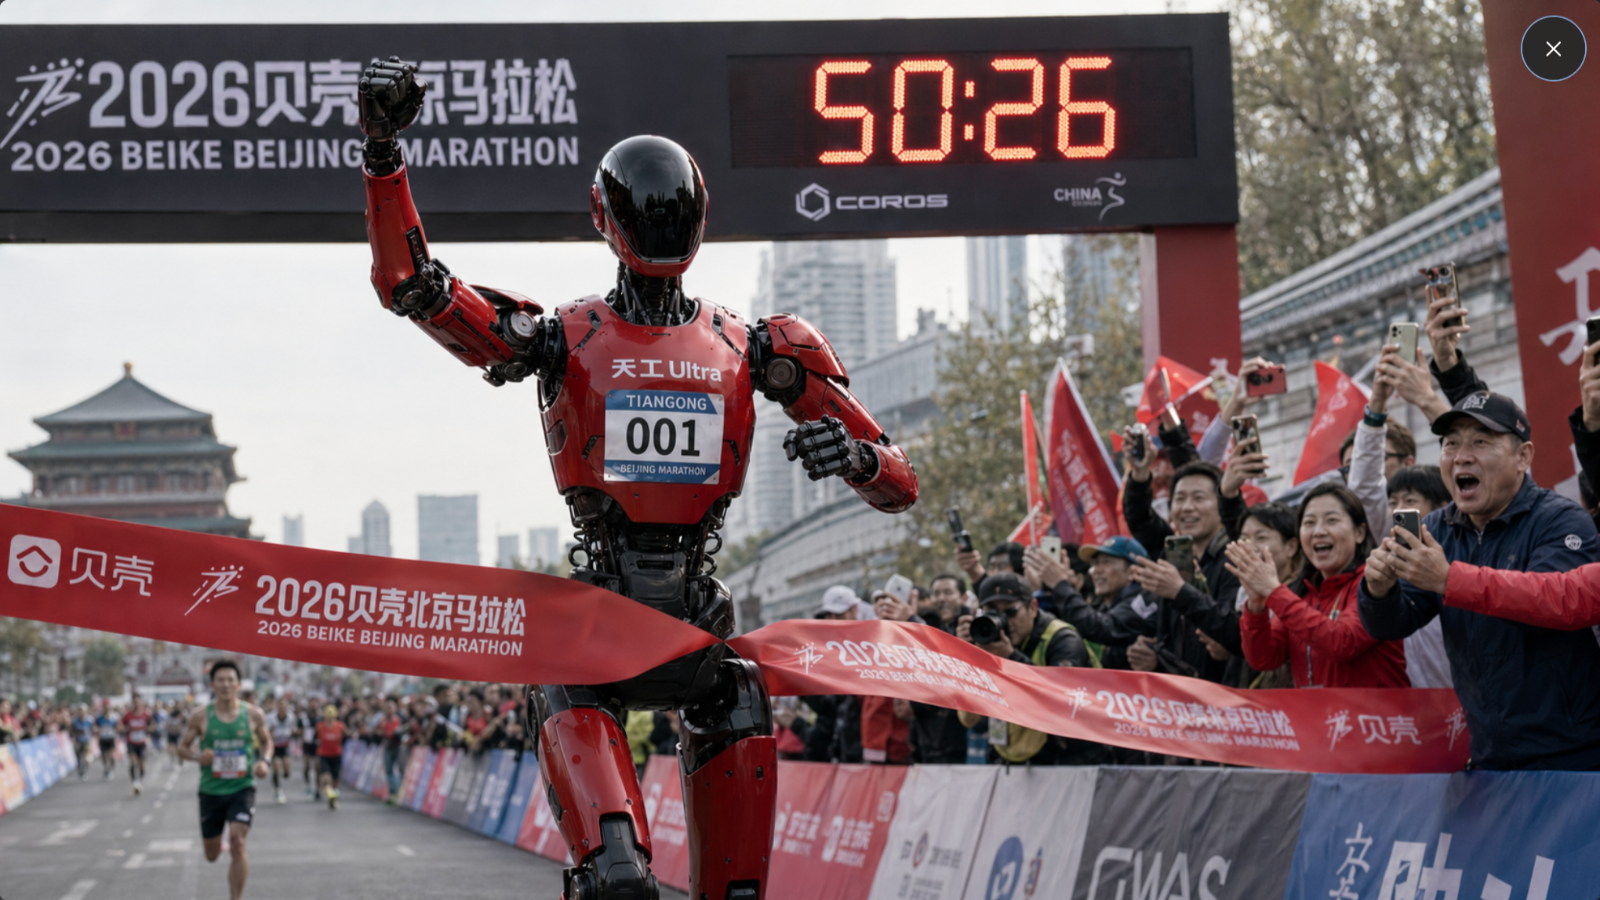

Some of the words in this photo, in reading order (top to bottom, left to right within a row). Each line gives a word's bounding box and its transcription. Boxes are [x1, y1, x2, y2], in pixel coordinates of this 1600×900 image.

[88, 58, 578, 128] 2026贝壳京马拉松
[814, 56, 1116, 164] 50:26
[11, 141, 112, 171] 2026
[121, 139, 222, 170] BEIKE
[234, 138, 363, 169] BEIJING
[402, 137, 579, 167] MARATHON
[836, 194, 948, 209] COROS
[1053, 187, 1102, 202] CHINA
[612, 359, 664, 378] 天工
[669, 360, 722, 382] Ultra
[626, 395, 707, 411] TIANGONG
[626, 417, 700, 457] 001
[620, 464, 656, 474] BEIJING
[658, 465, 706, 476] MARATHON
[69, 547, 154, 597] 贝壳
[255, 575, 526, 637] 2026贝壳北京马拉松
[257, 620, 302, 638] 2026
[306, 625, 355, 644] BEIKE
[360, 629, 425, 650] BEIJING
[430, 635, 523, 657] MARATHON
[1114, 721, 1148, 737] 2026
[1150, 726, 1185, 741] BEIKE
[1233, 734, 1301, 751] MARATHON
[1358, 714, 1422, 745] 贝壳
